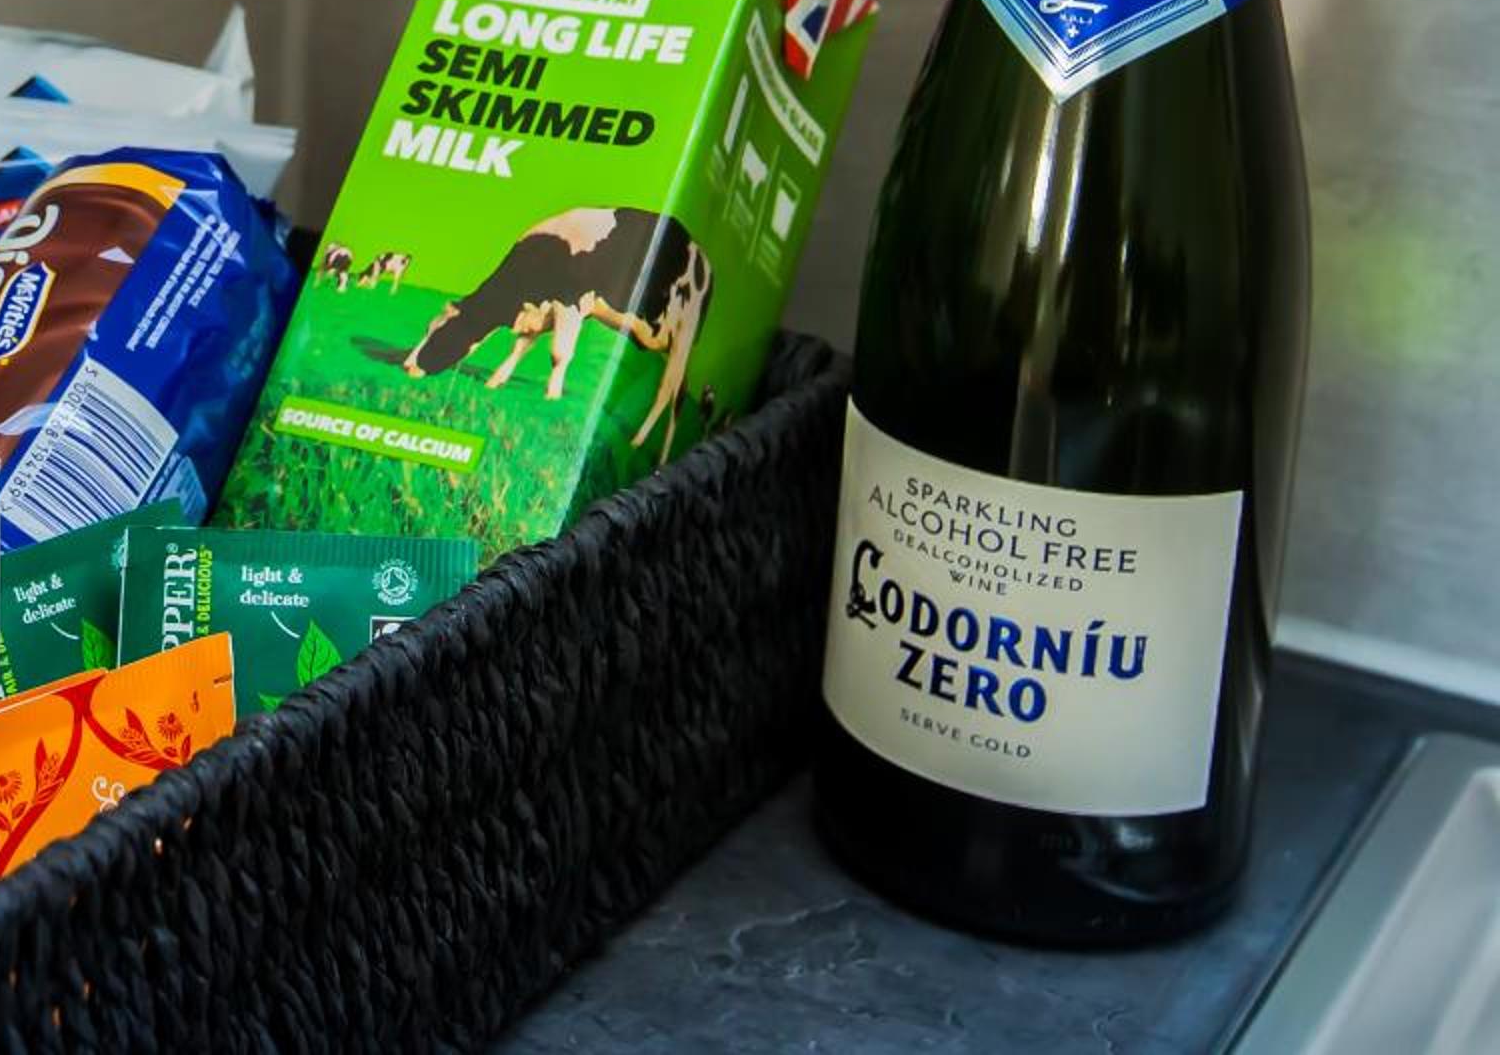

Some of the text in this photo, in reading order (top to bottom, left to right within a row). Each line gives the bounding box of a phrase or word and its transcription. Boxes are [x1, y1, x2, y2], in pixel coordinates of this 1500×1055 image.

[417, 39, 549, 92] SEMI
[586, 21, 694, 63] LIFE
[400, 80, 655, 146] SKIMMED
[383, 121, 524, 178] MILK
[280, 407, 472, 464] SOURCE OF CALCIUM
[869, 485, 1138, 574] ALCOHOL FREE
[906, 478, 1077, 538] SPARKLING
[13, 572, 64, 604] light &
[197, 550, 213, 621] DELICIOUS
[241, 566, 303, 587] light &
[893, 529, 1084, 592] DEALCOHOLIZED
[948, 569, 1008, 595] WINE
[22, 594, 77, 624] delicate
[240, 590, 310, 608] delicate
[846, 539, 1148, 679] CODORNÍU
[895, 641, 1047, 722] ZERO
[900, 708, 1031, 758] SERVE COLD
